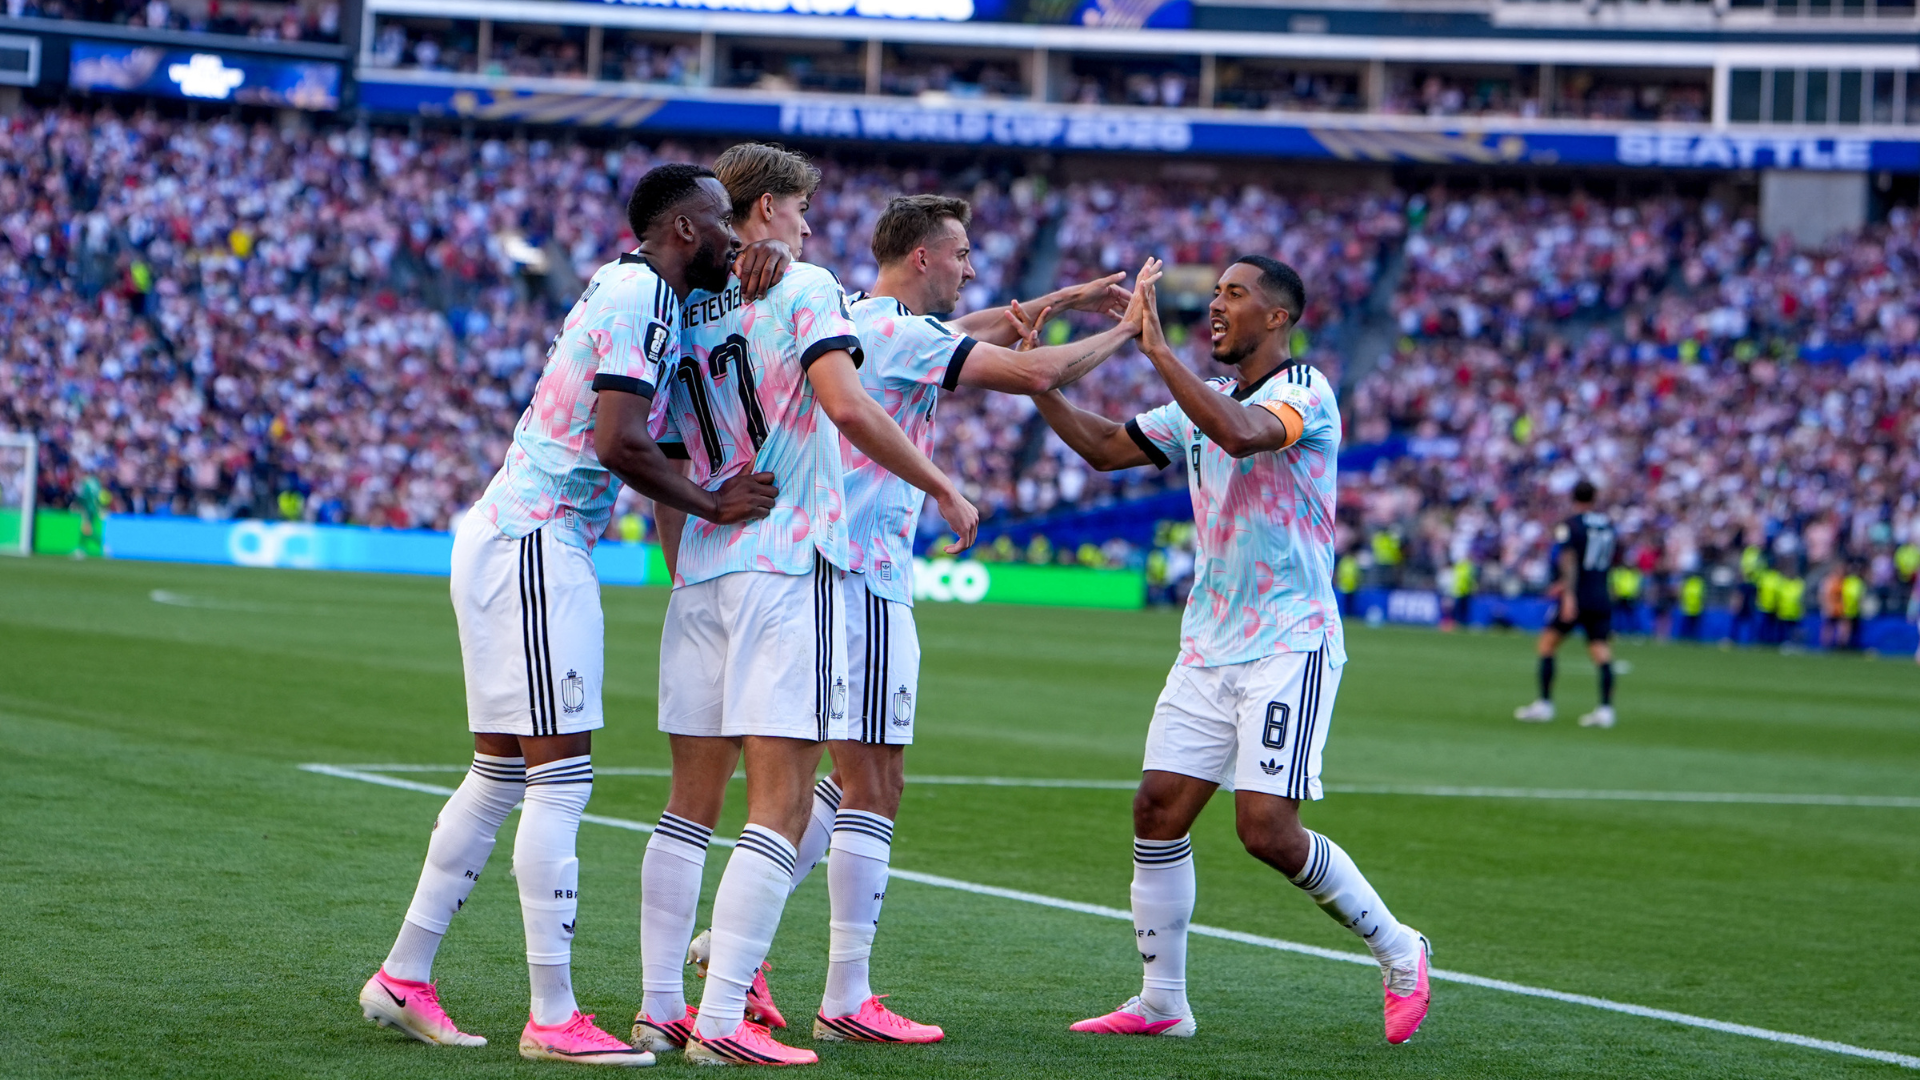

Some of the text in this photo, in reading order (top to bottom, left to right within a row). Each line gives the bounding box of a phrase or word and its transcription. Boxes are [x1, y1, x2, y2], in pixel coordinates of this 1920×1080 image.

[780, 103, 1191, 150] FIFA WORLD CUP 2026
[1617, 134, 1869, 168] SEATTLE
[676, 333, 770, 477] 17
[1261, 700, 1291, 751] 8
